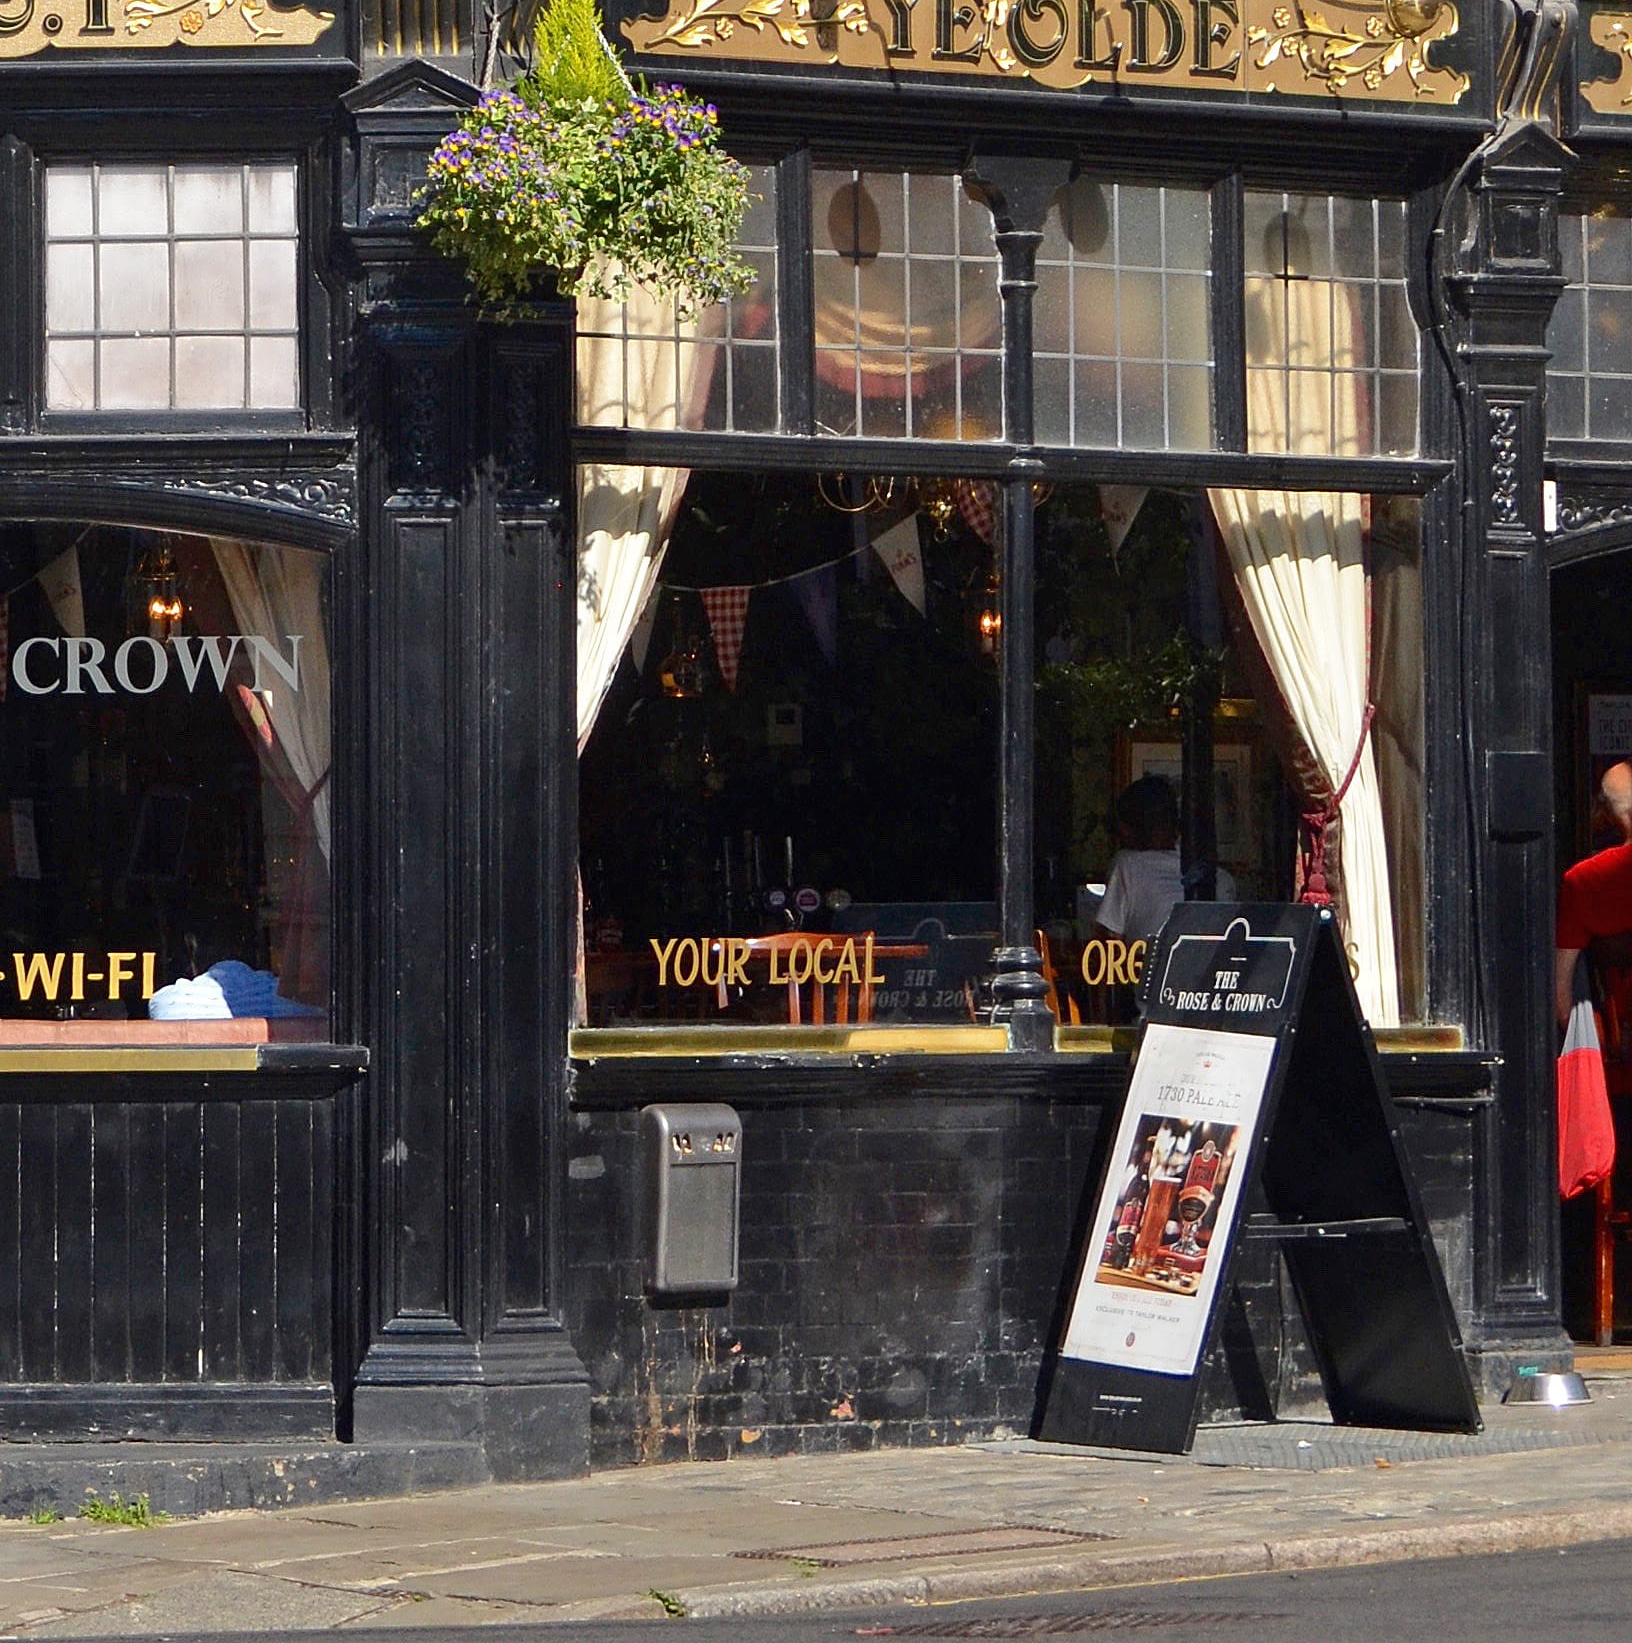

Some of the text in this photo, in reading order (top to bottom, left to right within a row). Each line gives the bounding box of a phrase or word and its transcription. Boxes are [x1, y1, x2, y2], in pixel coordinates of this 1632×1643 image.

[12, 634, 303, 696] CROWN
[12, 952, 156, 1001] WI-FI
[649, 937, 886, 987] YOUR LOCAL
[1213, 971, 1240, 990] THE
[1176, 991, 1267, 1012] ROSE & CROWN
